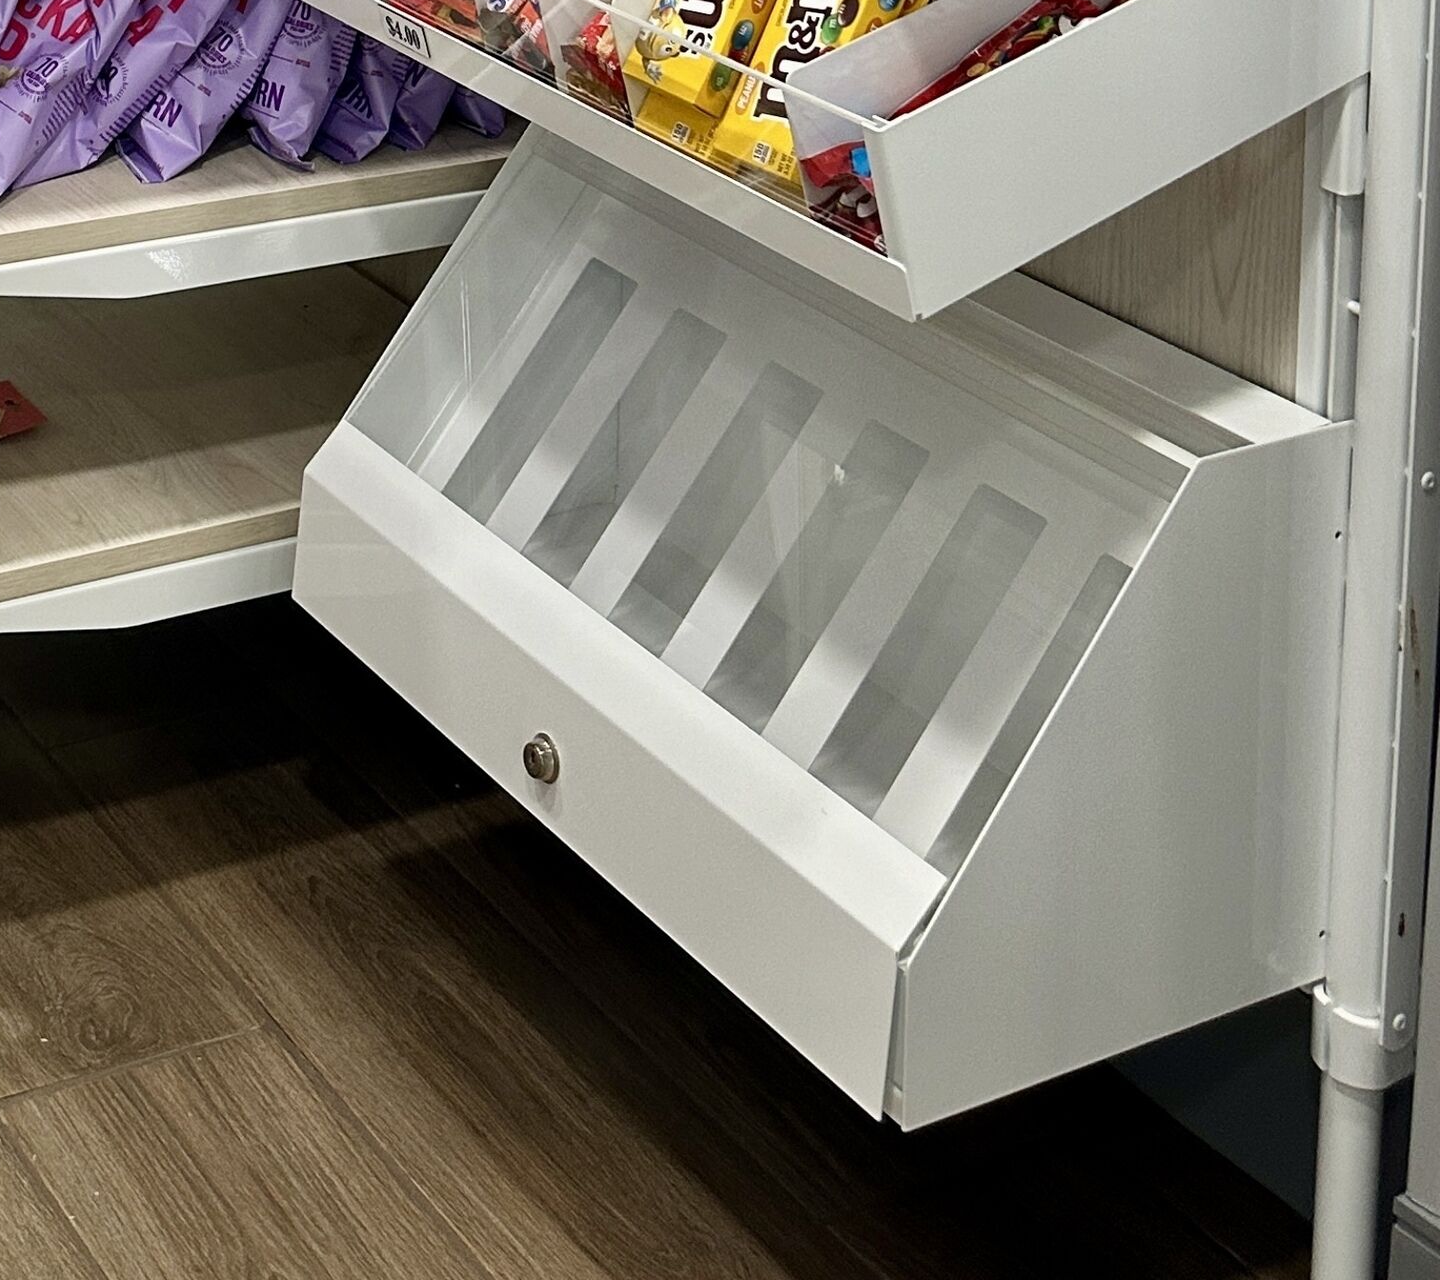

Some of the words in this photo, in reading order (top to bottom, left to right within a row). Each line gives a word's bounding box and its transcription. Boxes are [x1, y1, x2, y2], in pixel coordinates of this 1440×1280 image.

[215, 25, 234, 53] 70
[384, 15, 420, 51] $4.00
[35, 56, 61, 79] 70
[144, 91, 184, 129] RN
[258, 76, 286, 113] RN
